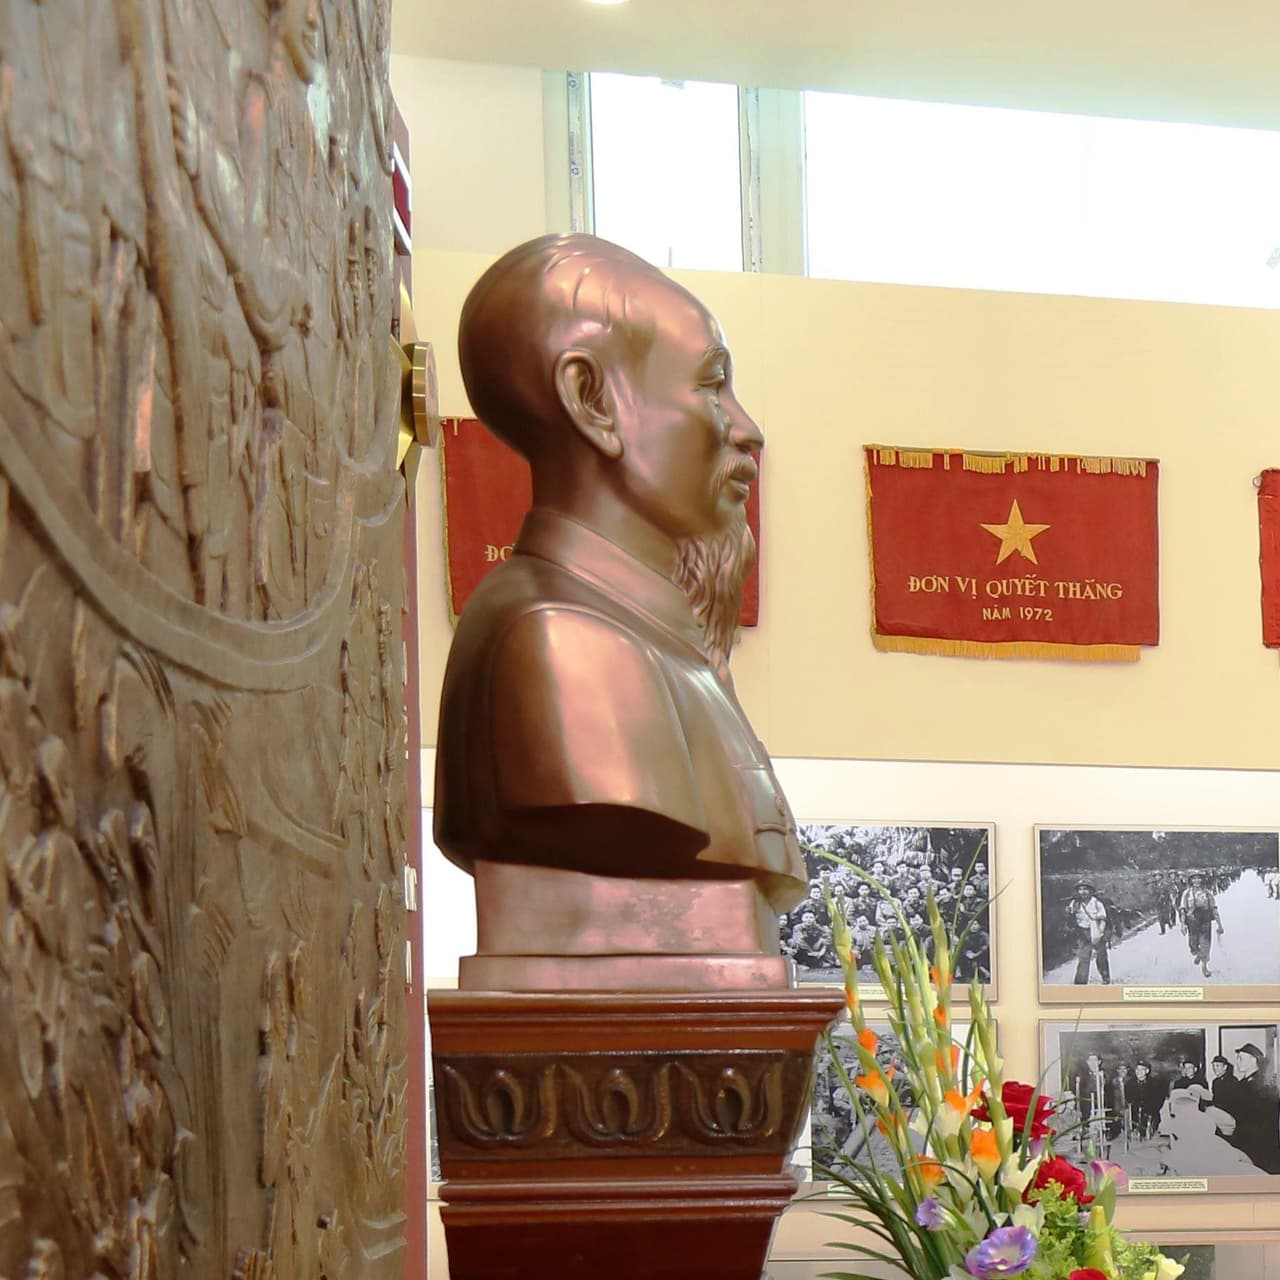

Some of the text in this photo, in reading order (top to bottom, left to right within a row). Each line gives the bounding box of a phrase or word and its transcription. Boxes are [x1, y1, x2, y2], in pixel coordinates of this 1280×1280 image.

[908, 575, 949, 593] ĐƠN
[955, 576, 977, 600] VỊ
[985, 574, 1049, 599] QUYẾT
[1019, 606, 1053, 621] 1972
